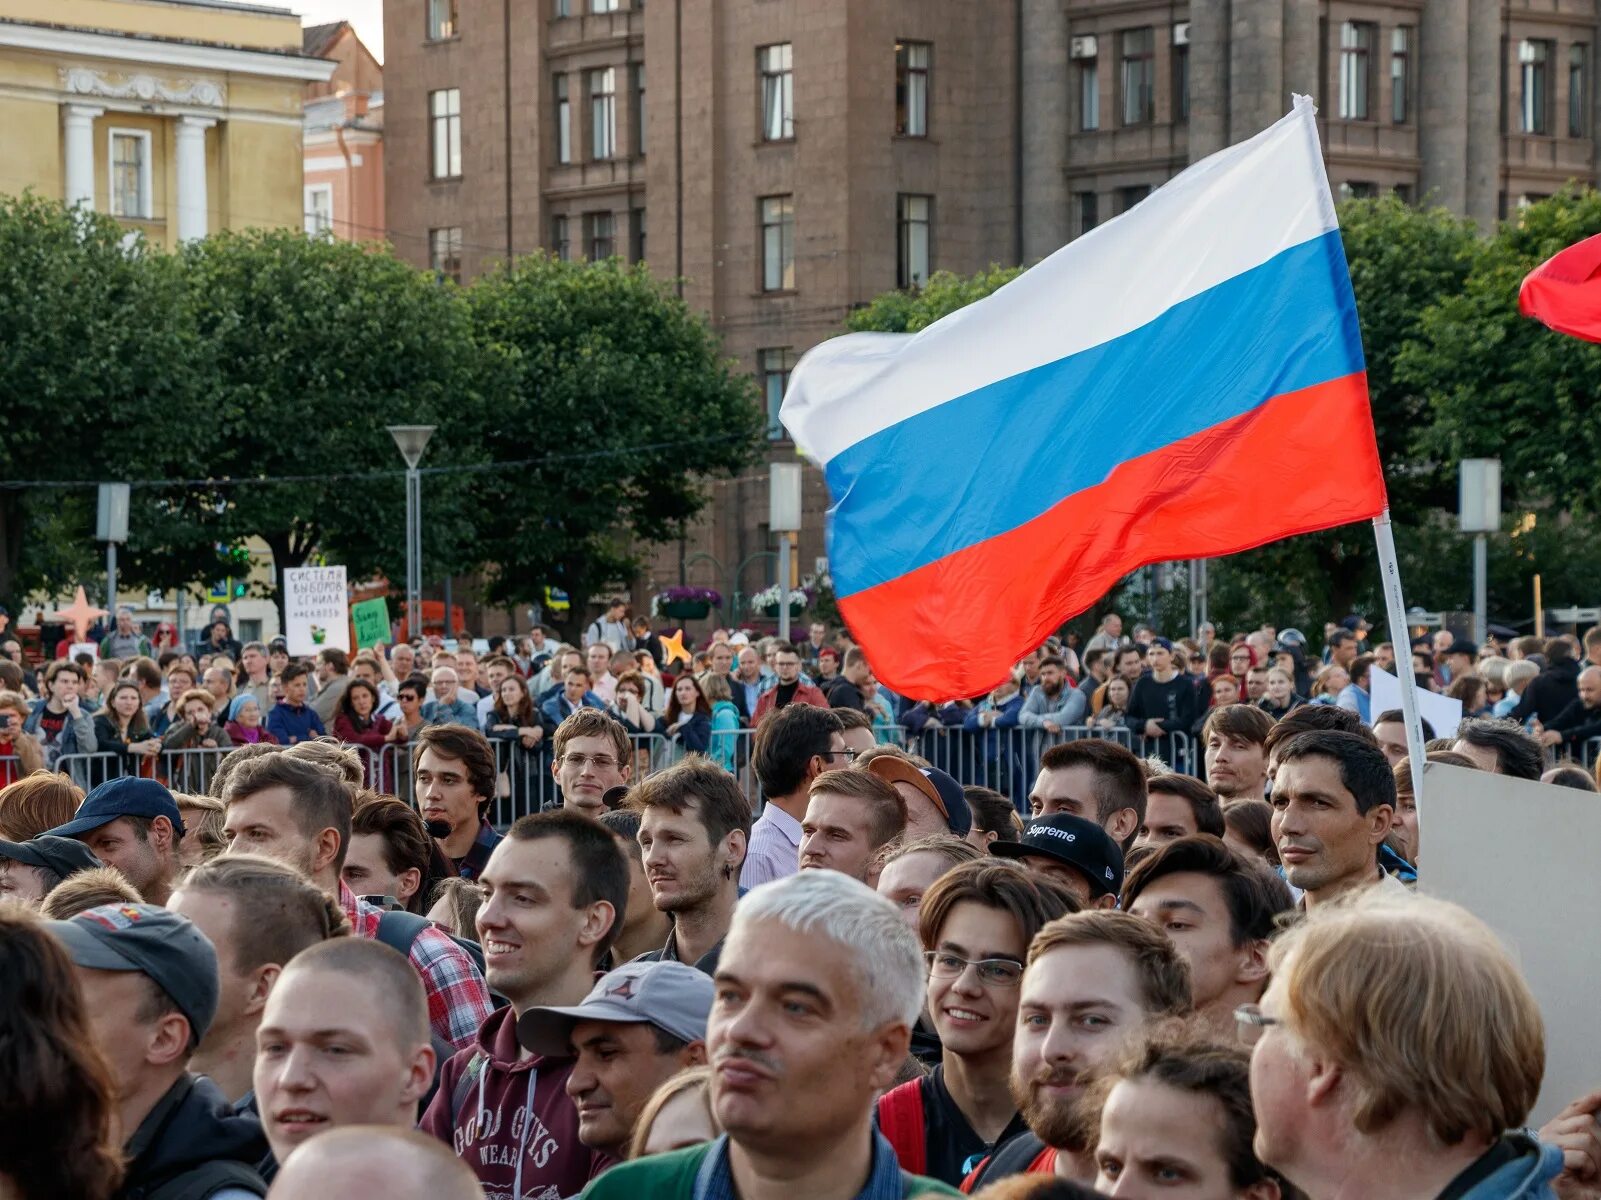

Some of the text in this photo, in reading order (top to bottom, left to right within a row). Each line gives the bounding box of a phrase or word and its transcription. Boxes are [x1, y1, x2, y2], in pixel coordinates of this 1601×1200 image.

[293, 582, 343, 594] ВЫБОРОВ
[297, 594, 341, 606] СГНИЛА
[1027, 824, 1076, 842] Supreme
[480, 1144, 518, 1168] WEAR
